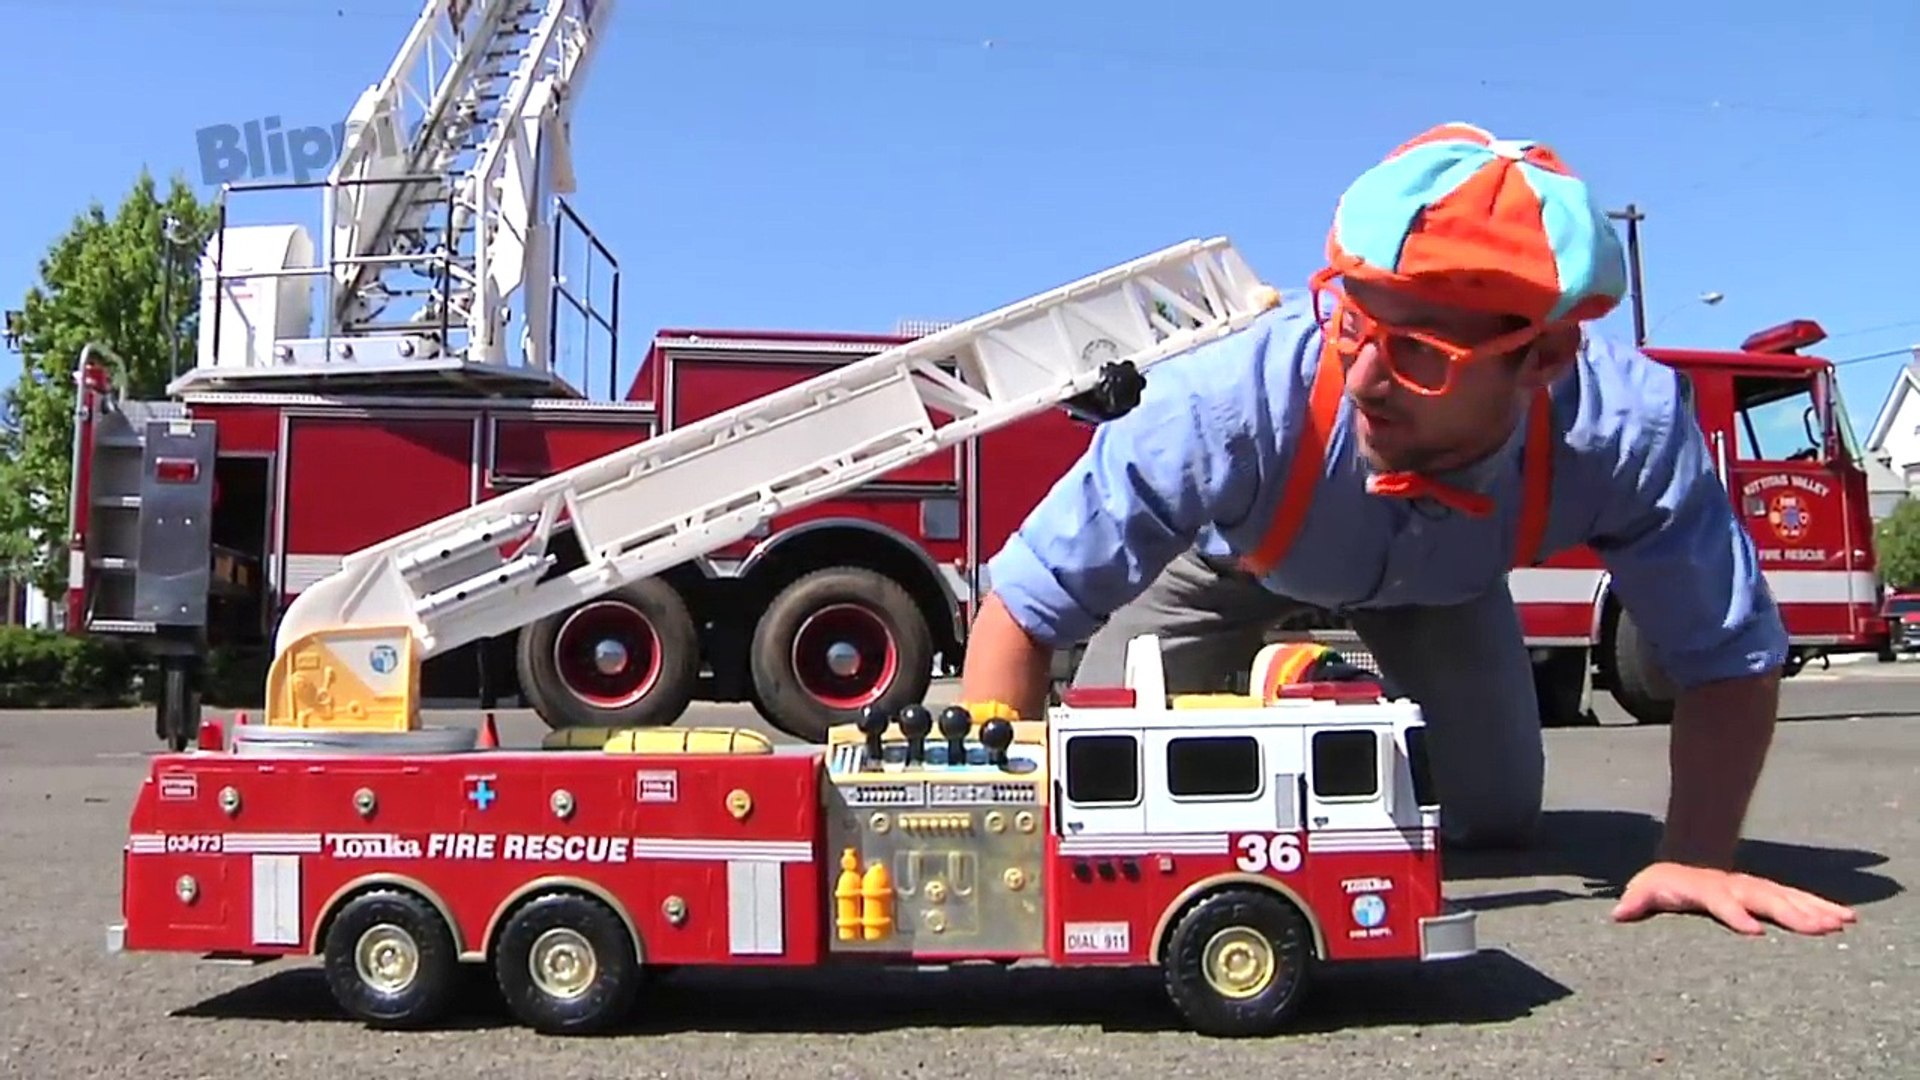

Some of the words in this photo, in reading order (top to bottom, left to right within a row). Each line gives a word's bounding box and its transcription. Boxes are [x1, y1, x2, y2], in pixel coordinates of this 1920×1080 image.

[1791, 475, 1829, 497] VALLEY
[167, 834, 222, 852] 03473
[427, 833, 497, 859] FIRE
[503, 835, 629, 862] RESCUE
[1236, 833, 1301, 873] 36
[1068, 934, 1098, 950] DIAL
[1104, 934, 1126, 949] 911
